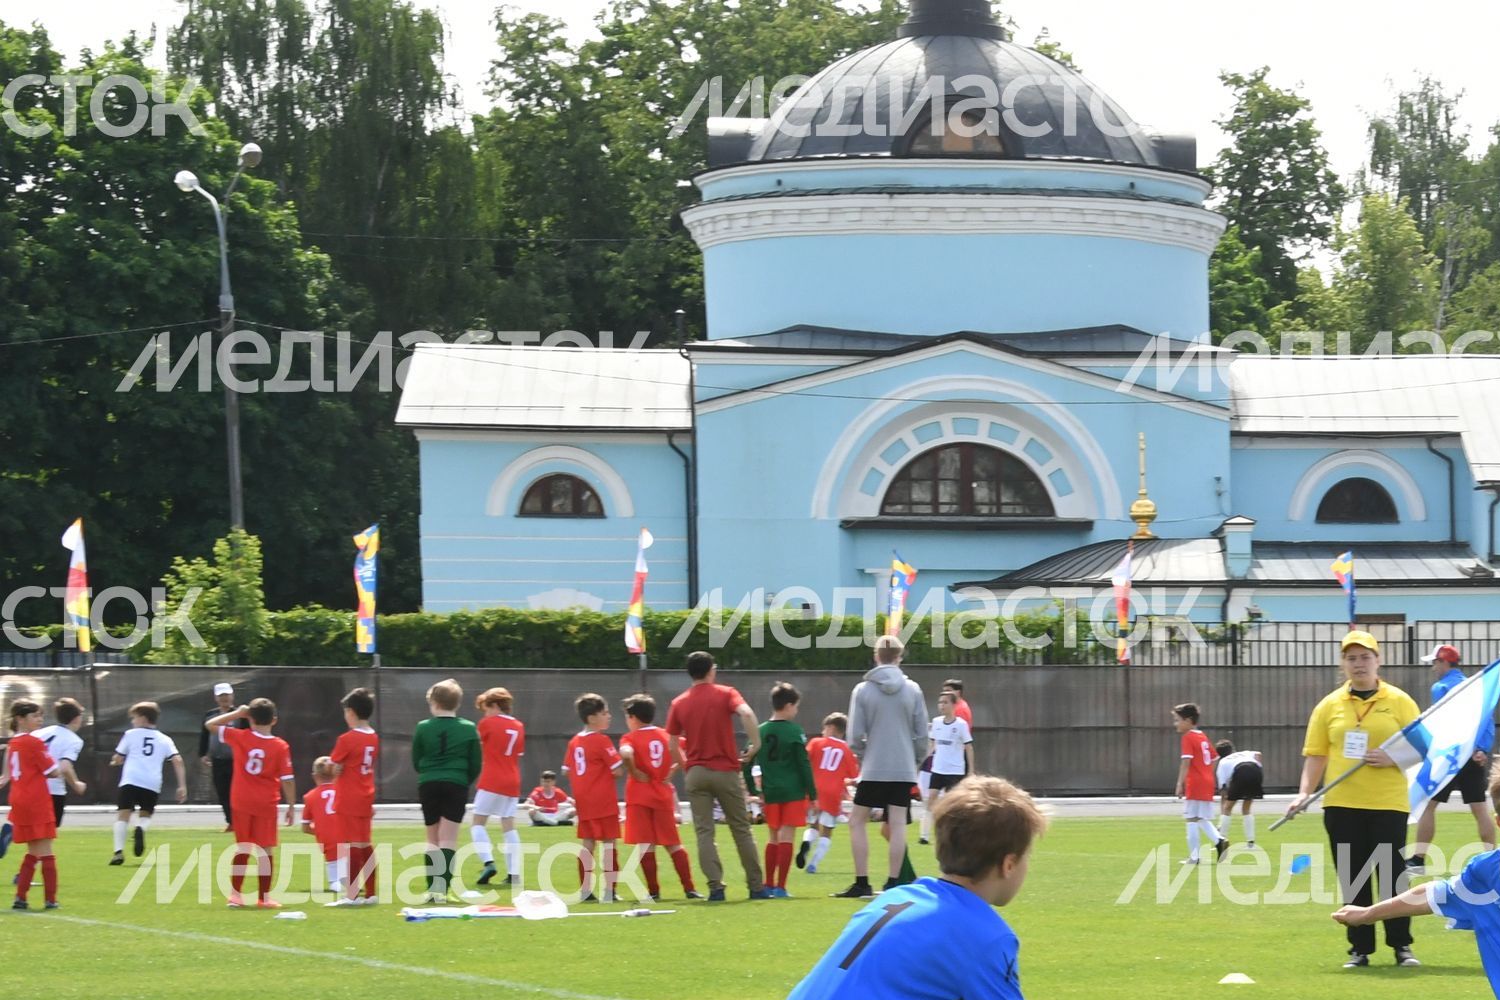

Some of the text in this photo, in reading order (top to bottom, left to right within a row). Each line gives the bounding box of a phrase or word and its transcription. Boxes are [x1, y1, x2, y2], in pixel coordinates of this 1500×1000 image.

[142, 737, 154, 756] 5
[437, 730, 448, 754] 1
[505, 729, 519, 756] 7
[649, 740, 664, 768] 9
[766, 734, 780, 762] 2
[245, 749, 265, 775] 6
[361, 746, 375, 774] 5
[574, 747, 586, 776] 8
[819, 746, 844, 771] 10
[839, 901, 915, 970] 1
